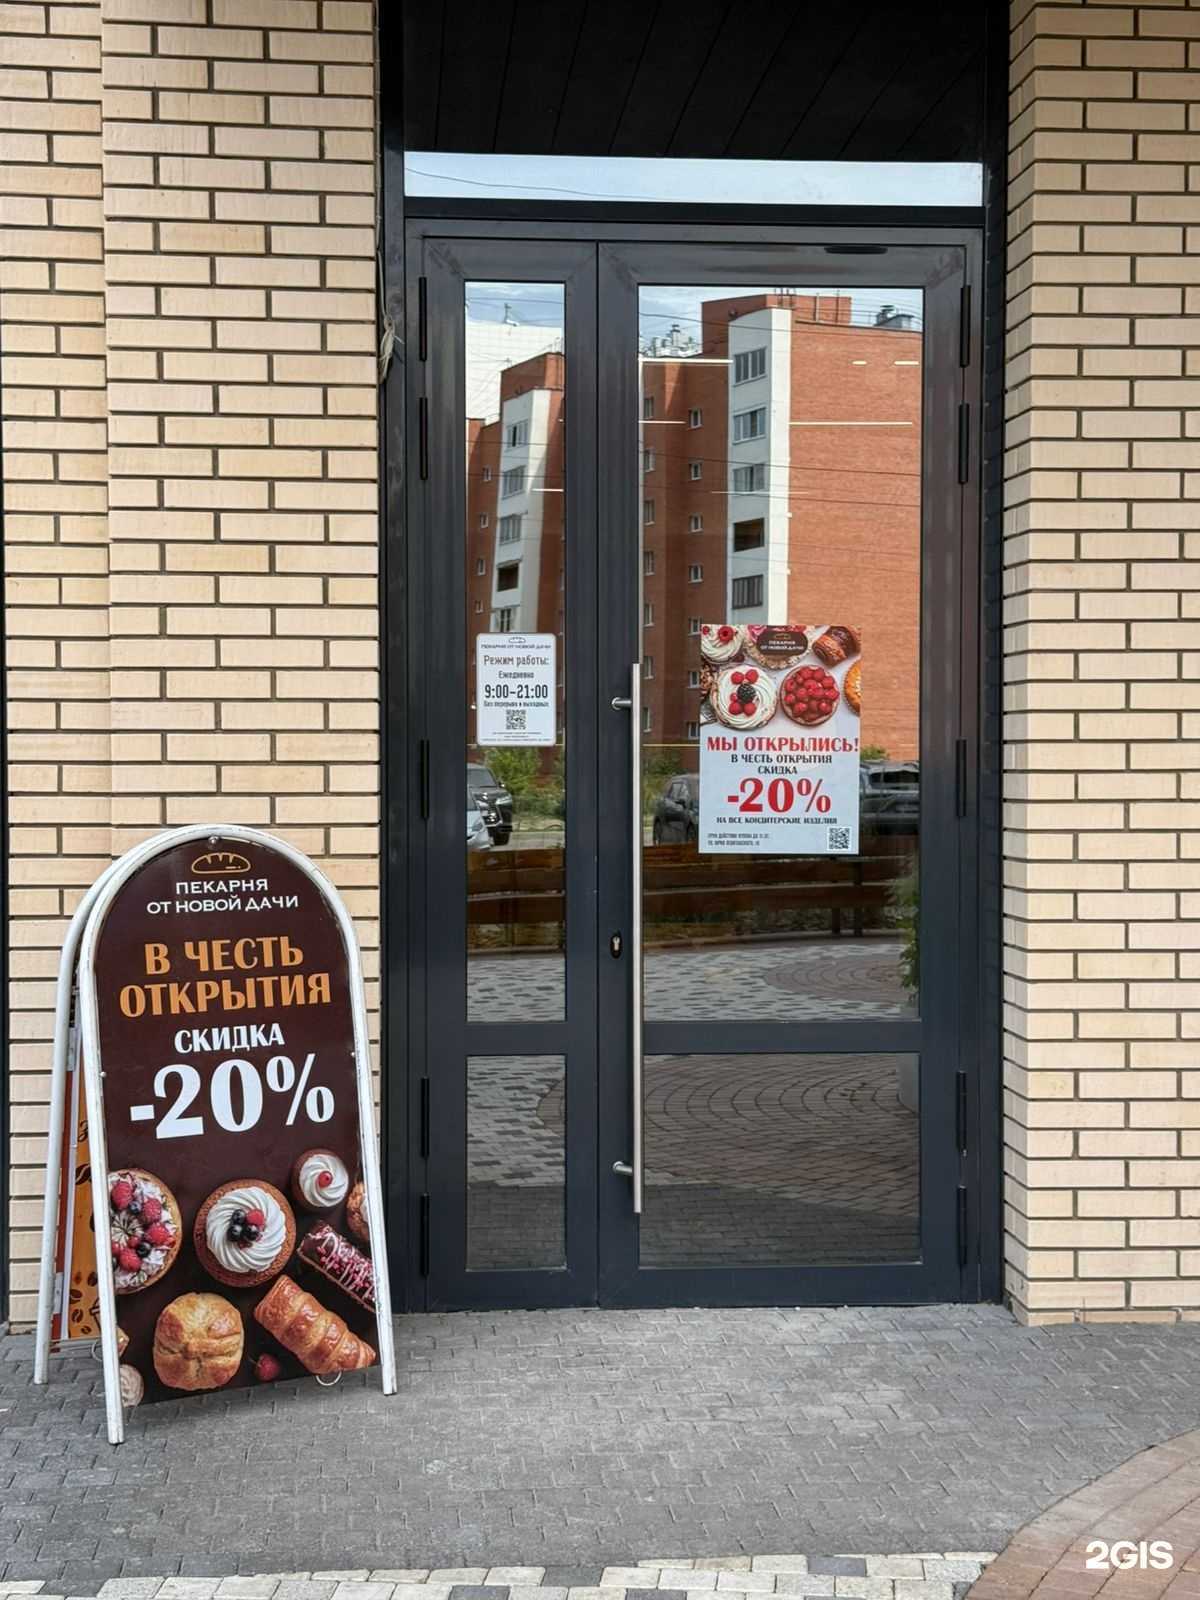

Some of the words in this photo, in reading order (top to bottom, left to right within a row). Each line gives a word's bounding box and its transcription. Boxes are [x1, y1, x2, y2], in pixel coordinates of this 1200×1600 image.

[484, 655, 514, 665] Режим
[517, 655, 549, 667] работы:
[499, 671, 534, 680] Ежедневно
[707, 737, 737, 751] МЫ
[744, 737, 859, 752] ОТКРЫЛИСЬ!
[731, 755, 738, 763] В
[742, 754, 773, 763] ЧЕСТЬ
[776, 755, 832, 763] ОТКРЫТИЯ
[758, 766, 797, 775] СКИДКА
[728, 778, 831, 812] -20%
[176, 879, 268, 894] ПЕКАРНЯ
[147, 900, 172, 914] ОТ
[176, 896, 241, 913] НОВОЙ
[245, 896, 298, 912] ДАЧИ
[145, 943, 170, 975] В
[185, 936, 303, 972] ЧЕСТЬ
[120, 973, 331, 1017] ОТКРЫТИЯ
[175, 1023, 284, 1054] СКИДКА
[130, 1053, 334, 1140] -20%
